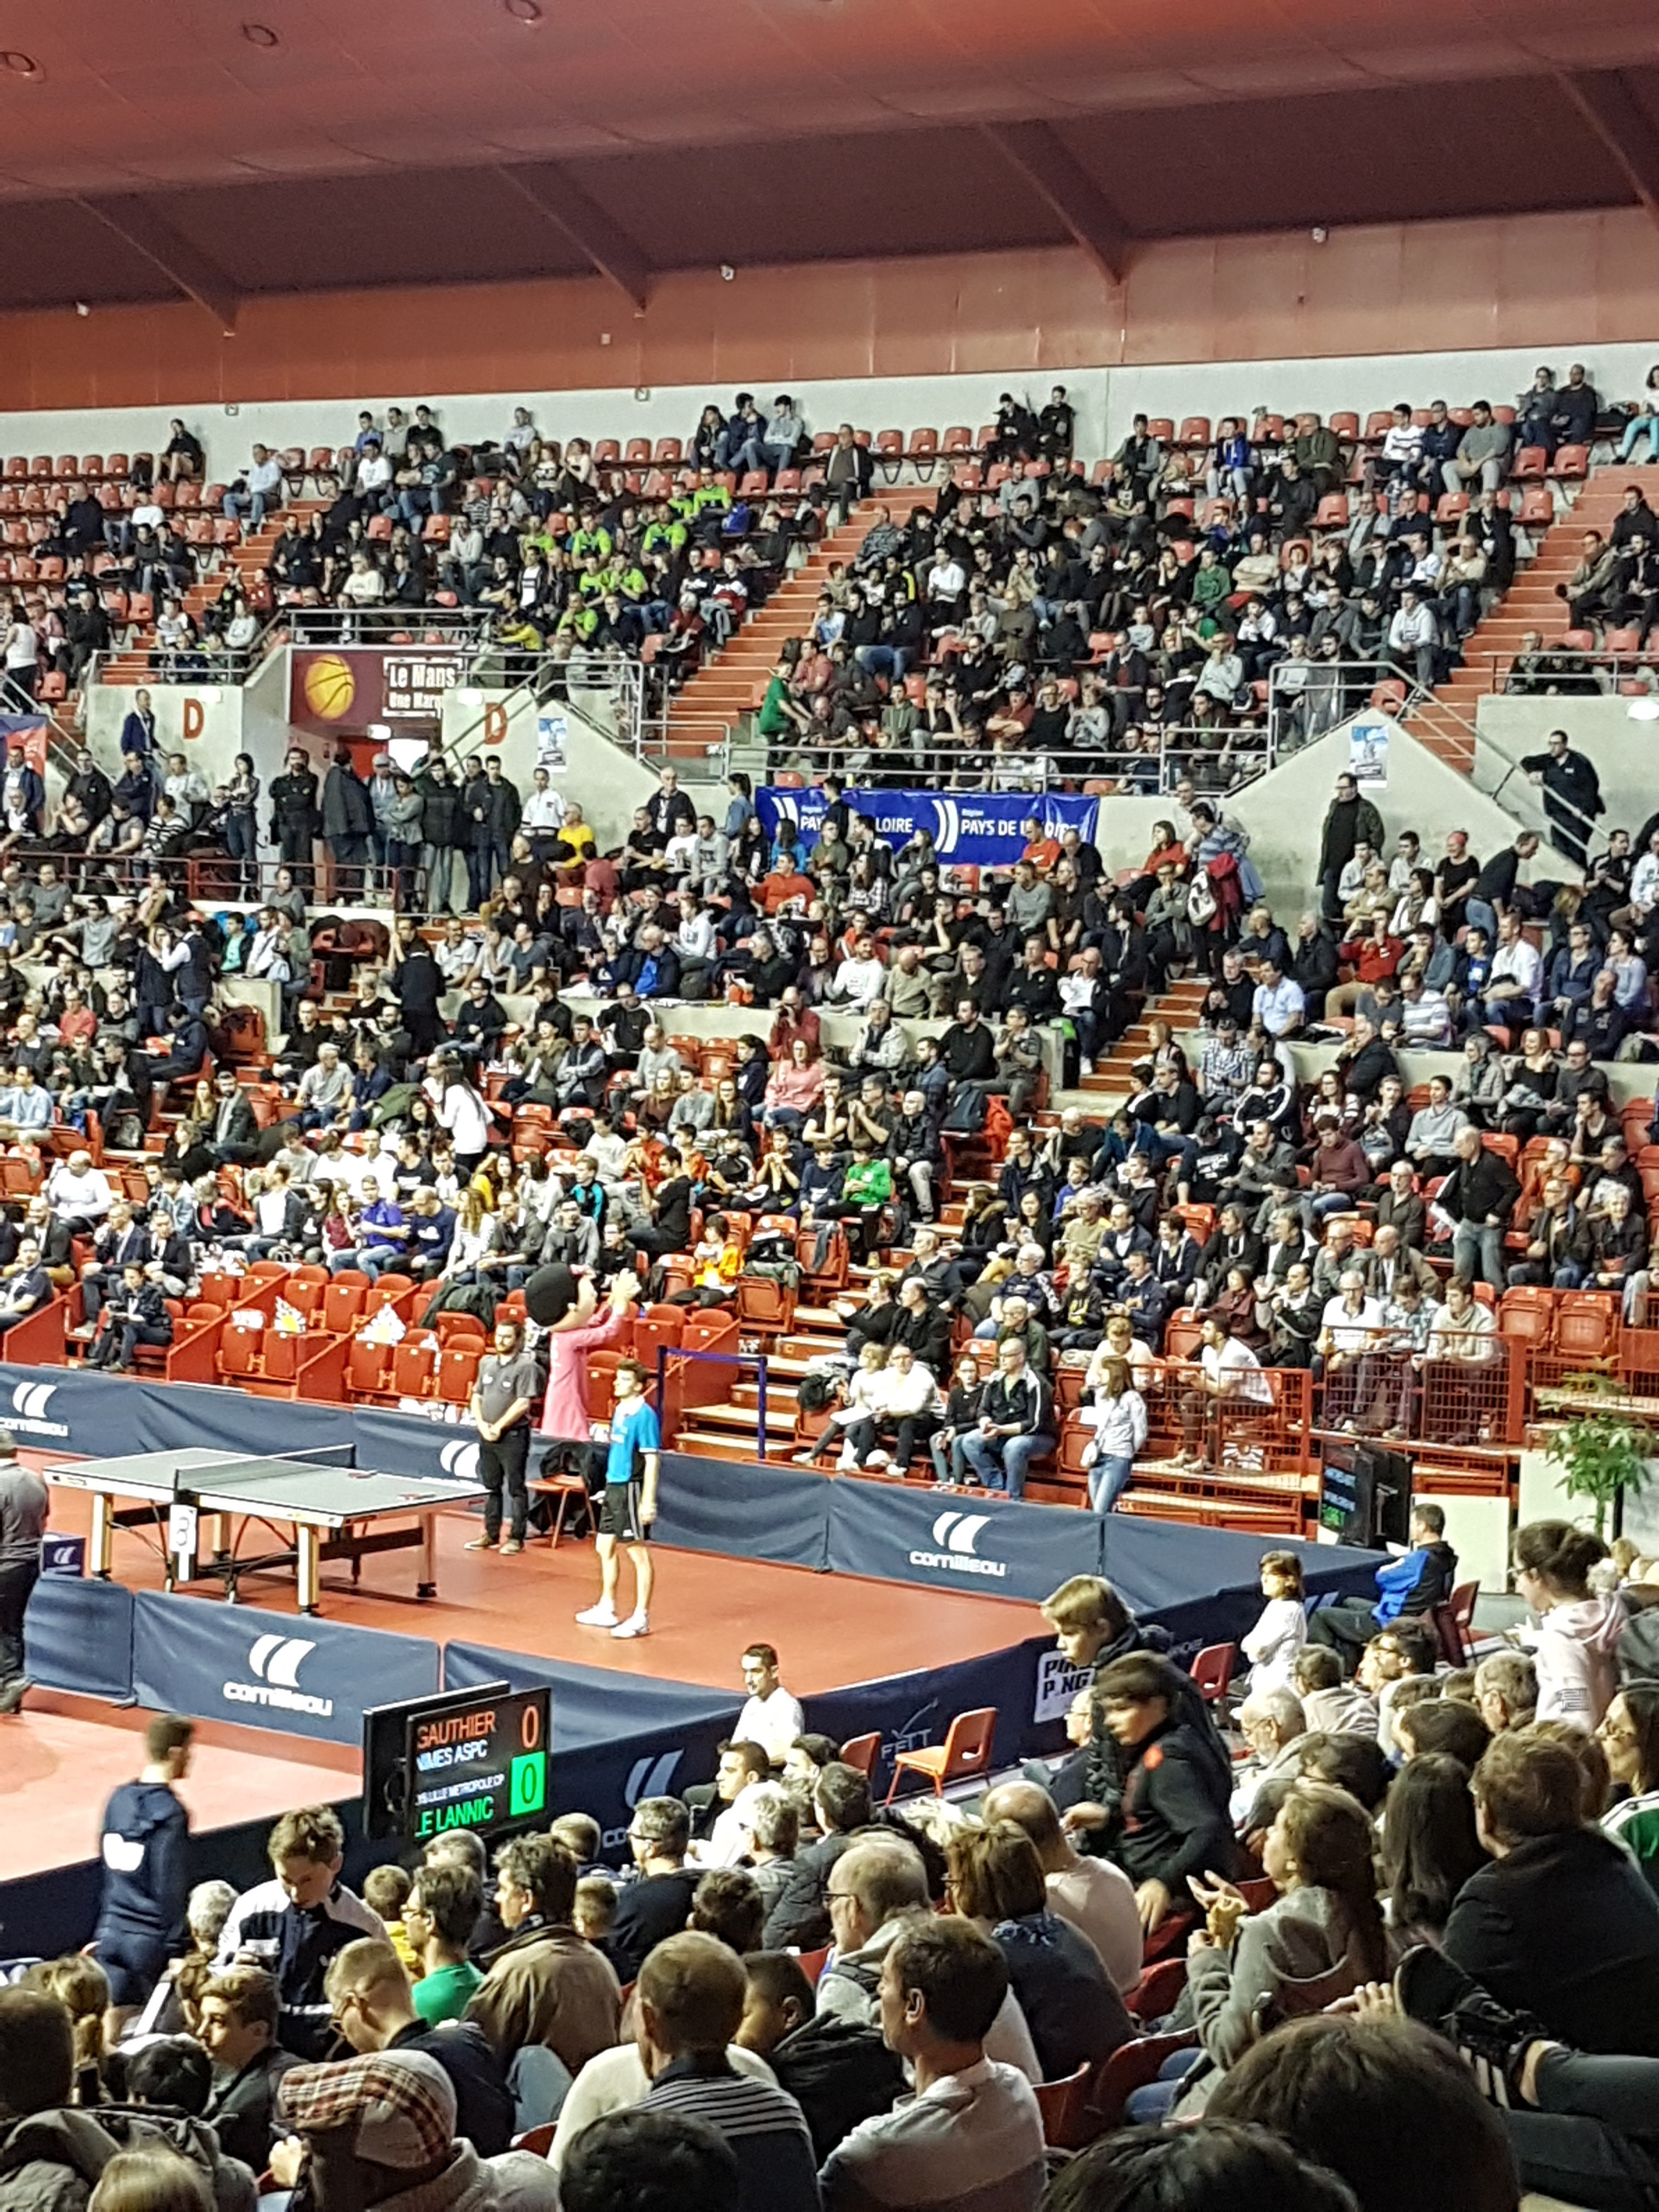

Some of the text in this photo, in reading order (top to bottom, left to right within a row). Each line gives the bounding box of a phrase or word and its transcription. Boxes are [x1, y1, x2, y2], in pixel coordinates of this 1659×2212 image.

[390, 664, 456, 688] Le Mans
[184, 698, 204, 739] D
[485, 702, 507, 744] D
[800, 815, 913, 833] PAY LOIRE
[961, 820, 995, 836] PAYS
[998, 821, 1017, 836] DE
[909, 1550, 1007, 1577] cornilleau
[417, 1711, 496, 1750] GAUTHIER
[522, 1705, 539, 1749] 0
[454, 1739, 488, 1764] ASPC
[521, 1763, 537, 1804] 0
[436, 1796, 494, 1832] LANNIC
